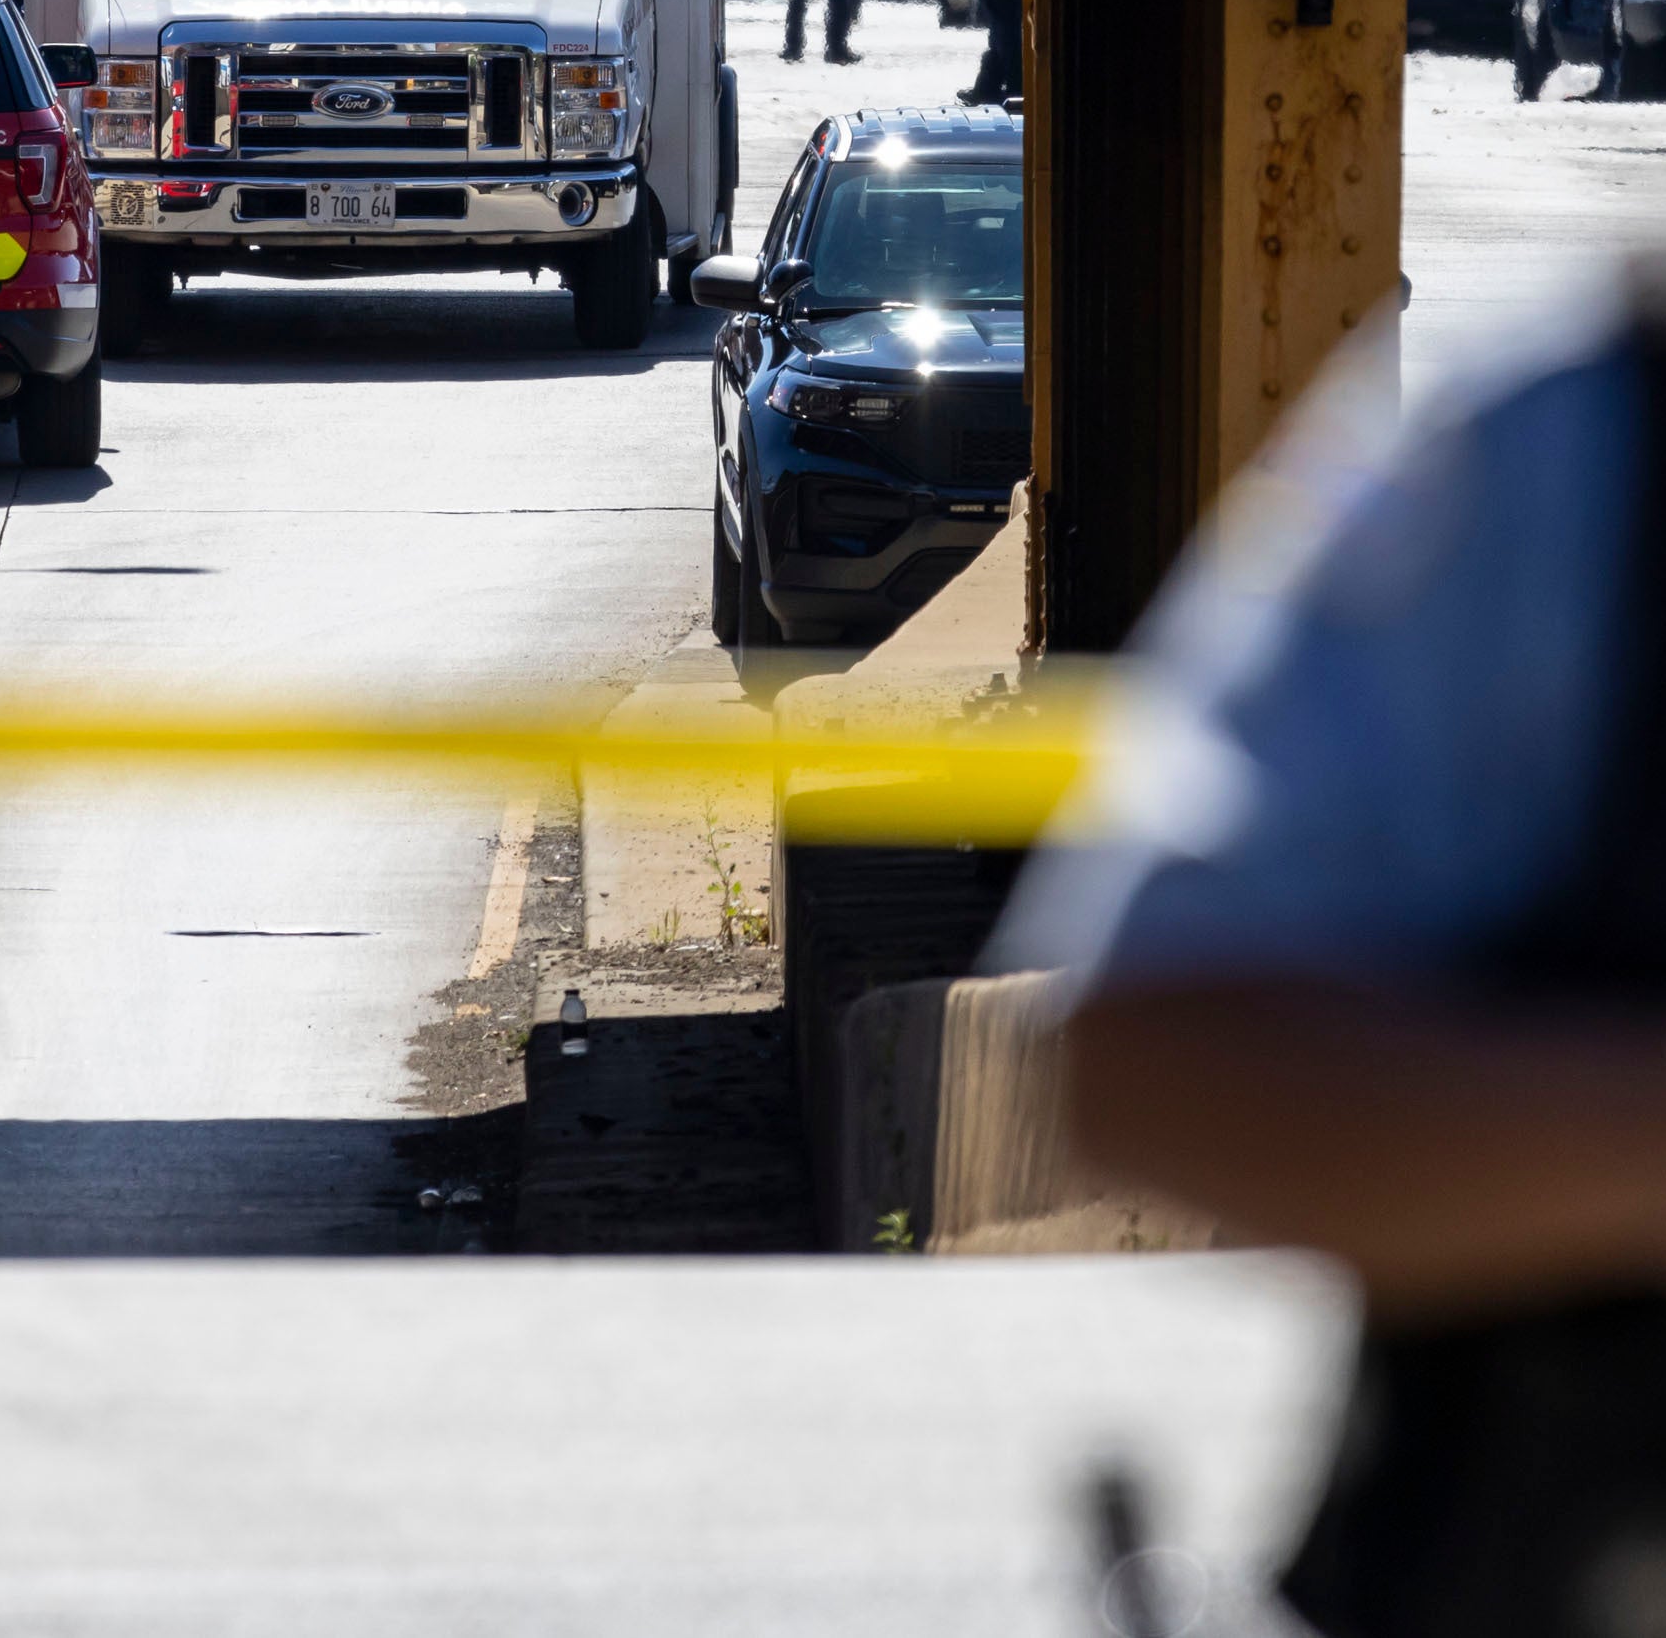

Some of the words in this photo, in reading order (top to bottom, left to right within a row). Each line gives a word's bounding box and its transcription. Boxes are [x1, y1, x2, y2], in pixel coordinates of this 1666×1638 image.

[553, 43, 589, 53] FDC224
[335, 93, 371, 110] Ford
[310, 195, 320, 216] 8
[331, 196, 361, 217] 700
[371, 196, 390, 217] 64
